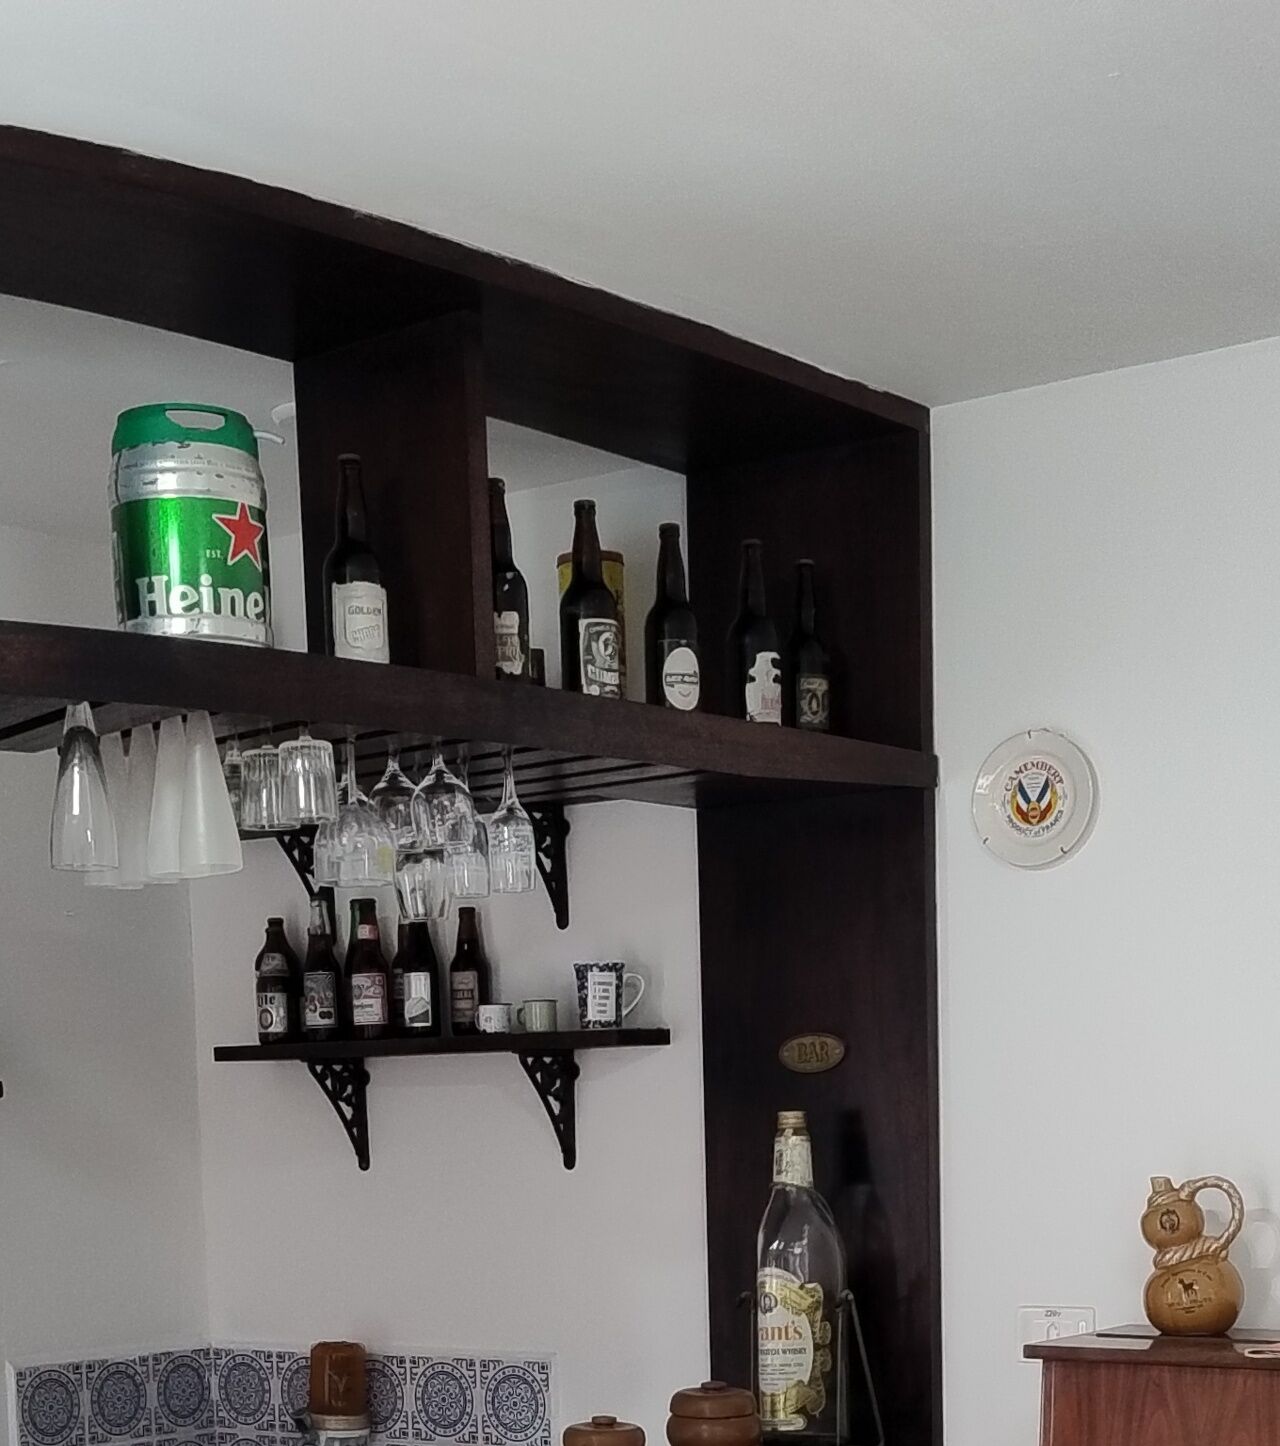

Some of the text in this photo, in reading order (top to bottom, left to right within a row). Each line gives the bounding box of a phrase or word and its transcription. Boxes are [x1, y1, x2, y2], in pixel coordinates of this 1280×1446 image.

[135, 573, 269, 625] Heine
[797, 1041, 830, 1064] BAR
[759, 1319, 804, 1341] ant's
